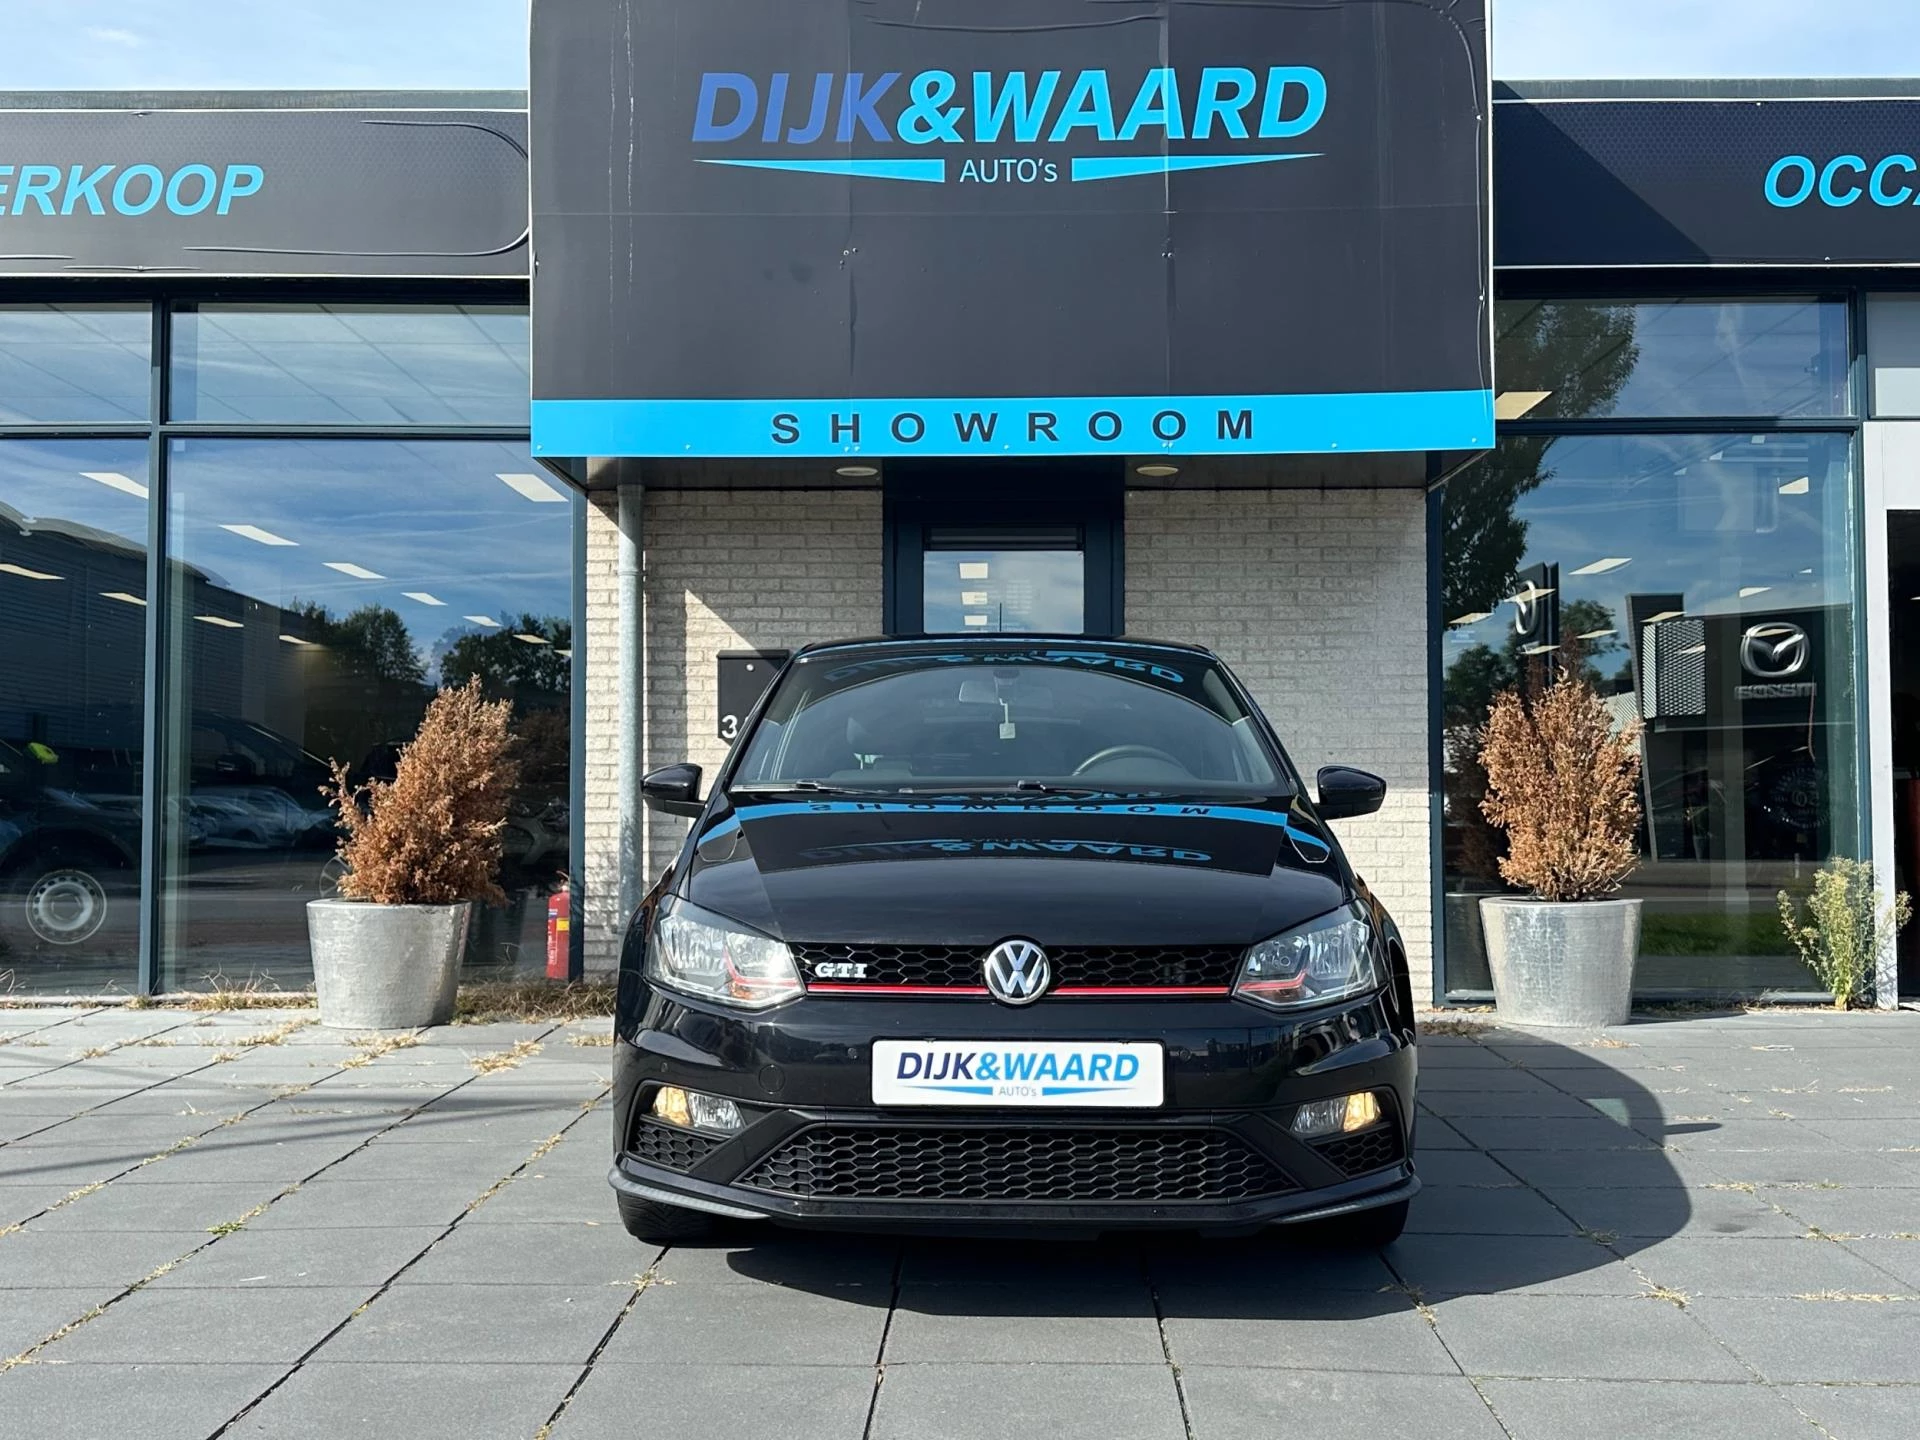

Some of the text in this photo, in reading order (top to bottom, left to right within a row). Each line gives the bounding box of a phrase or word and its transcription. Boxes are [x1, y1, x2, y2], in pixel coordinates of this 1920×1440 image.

[692, 65, 1328, 144] DIJK&WAARD
[959, 157, 1058, 183] AUTO's
[1764, 154, 1920, 207] OCC
[773, 411, 1254, 442] SHOWROOM
[721, 714, 749, 739] 3
[814, 962, 868, 979] GTI
[896, 1052, 1140, 1082] DIJK&WAARD
[998, 1085, 1037, 1098] AUTO's
